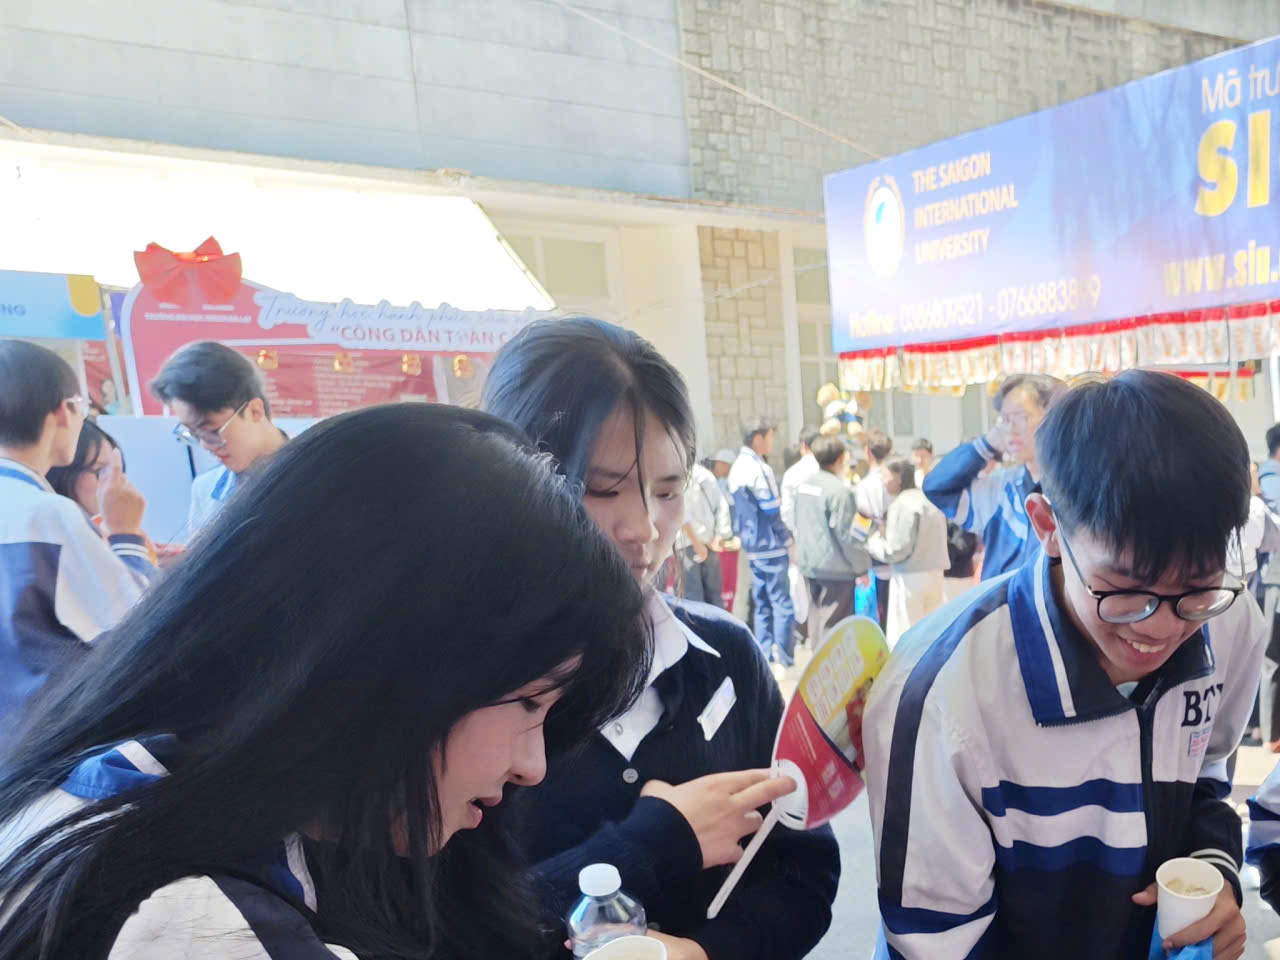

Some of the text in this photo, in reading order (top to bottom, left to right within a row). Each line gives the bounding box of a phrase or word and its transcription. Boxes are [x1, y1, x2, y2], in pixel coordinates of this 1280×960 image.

[1202, 68, 1242, 113] Mã
[912, 152, 992, 193] THE SAIGON
[914, 183, 1020, 229] INTERNATIONAL
